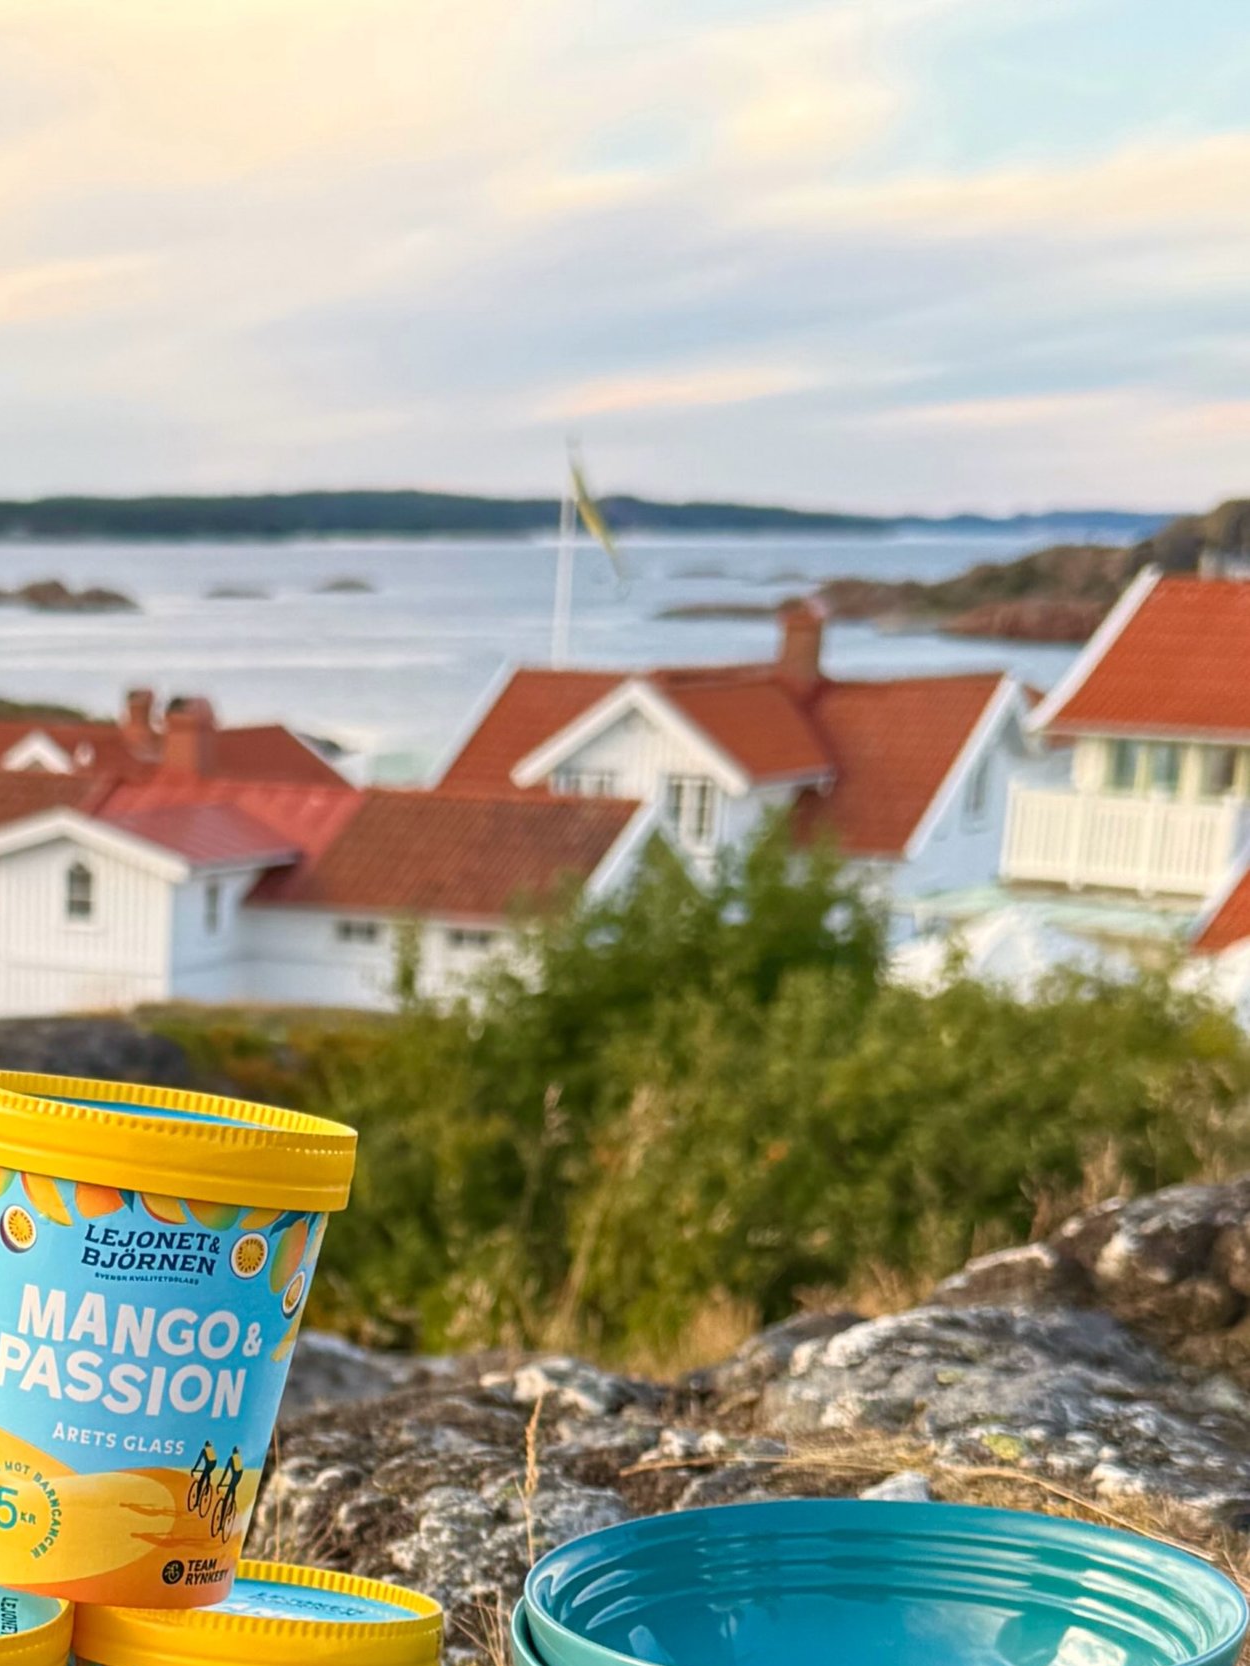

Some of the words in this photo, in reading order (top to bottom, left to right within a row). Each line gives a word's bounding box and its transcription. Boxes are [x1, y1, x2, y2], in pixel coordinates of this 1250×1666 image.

[81, 1246, 217, 1276] BJÖRNEN
[123, 1433, 186, 1455] GLASS
[5, 1461, 30, 1475] MOT
[31, 1472, 62, 1558] BARNCANCER
[20, 1511, 36, 1525] KR
[188, 1558, 218, 1571] TEAM
